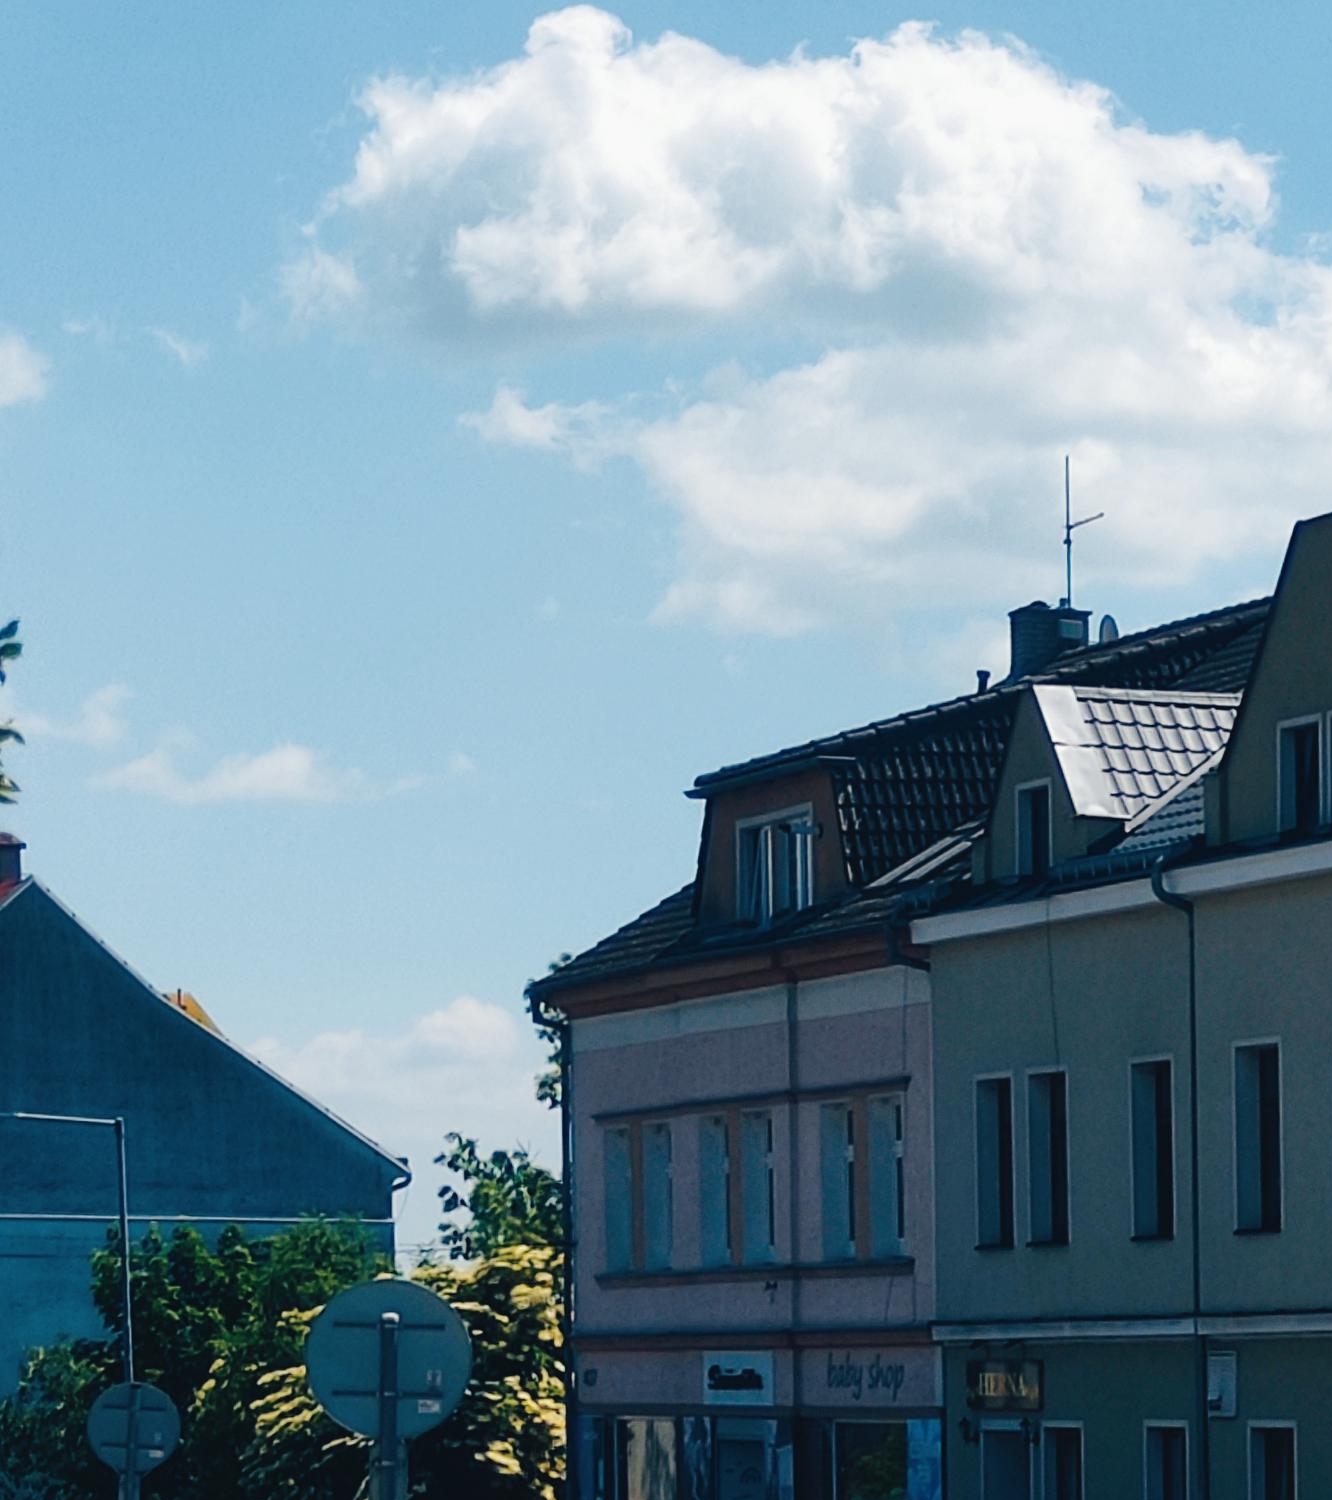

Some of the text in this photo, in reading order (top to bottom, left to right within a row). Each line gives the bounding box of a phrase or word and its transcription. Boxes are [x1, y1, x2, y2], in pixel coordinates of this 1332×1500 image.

[827, 1351, 905, 1402] baby shop
[977, 1370, 1026, 1397] HERNA
